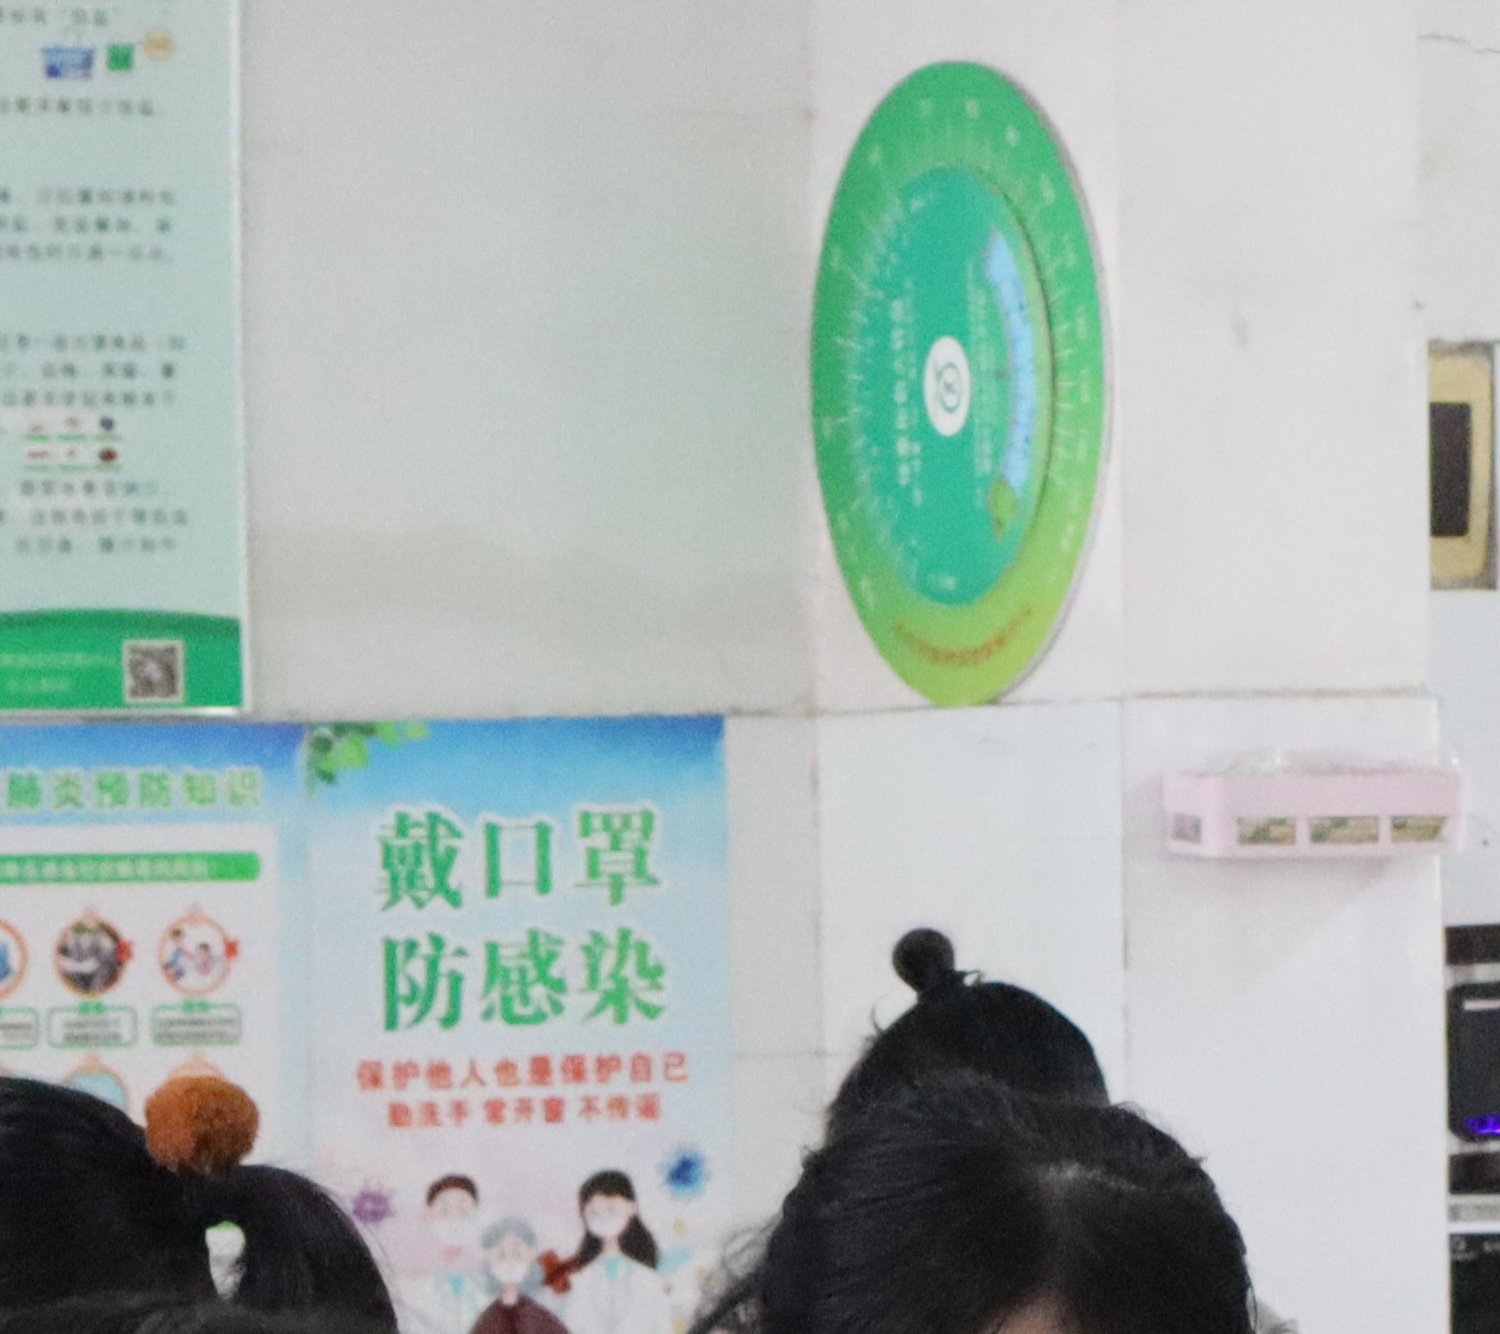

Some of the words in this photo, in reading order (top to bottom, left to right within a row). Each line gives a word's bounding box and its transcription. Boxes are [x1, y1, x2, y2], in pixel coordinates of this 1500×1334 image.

[377, 807, 662, 914] 戴口罩
[380, 926, 667, 1033] 防感染
[355, 1051, 689, 1092] 保护他人也是保护自己
